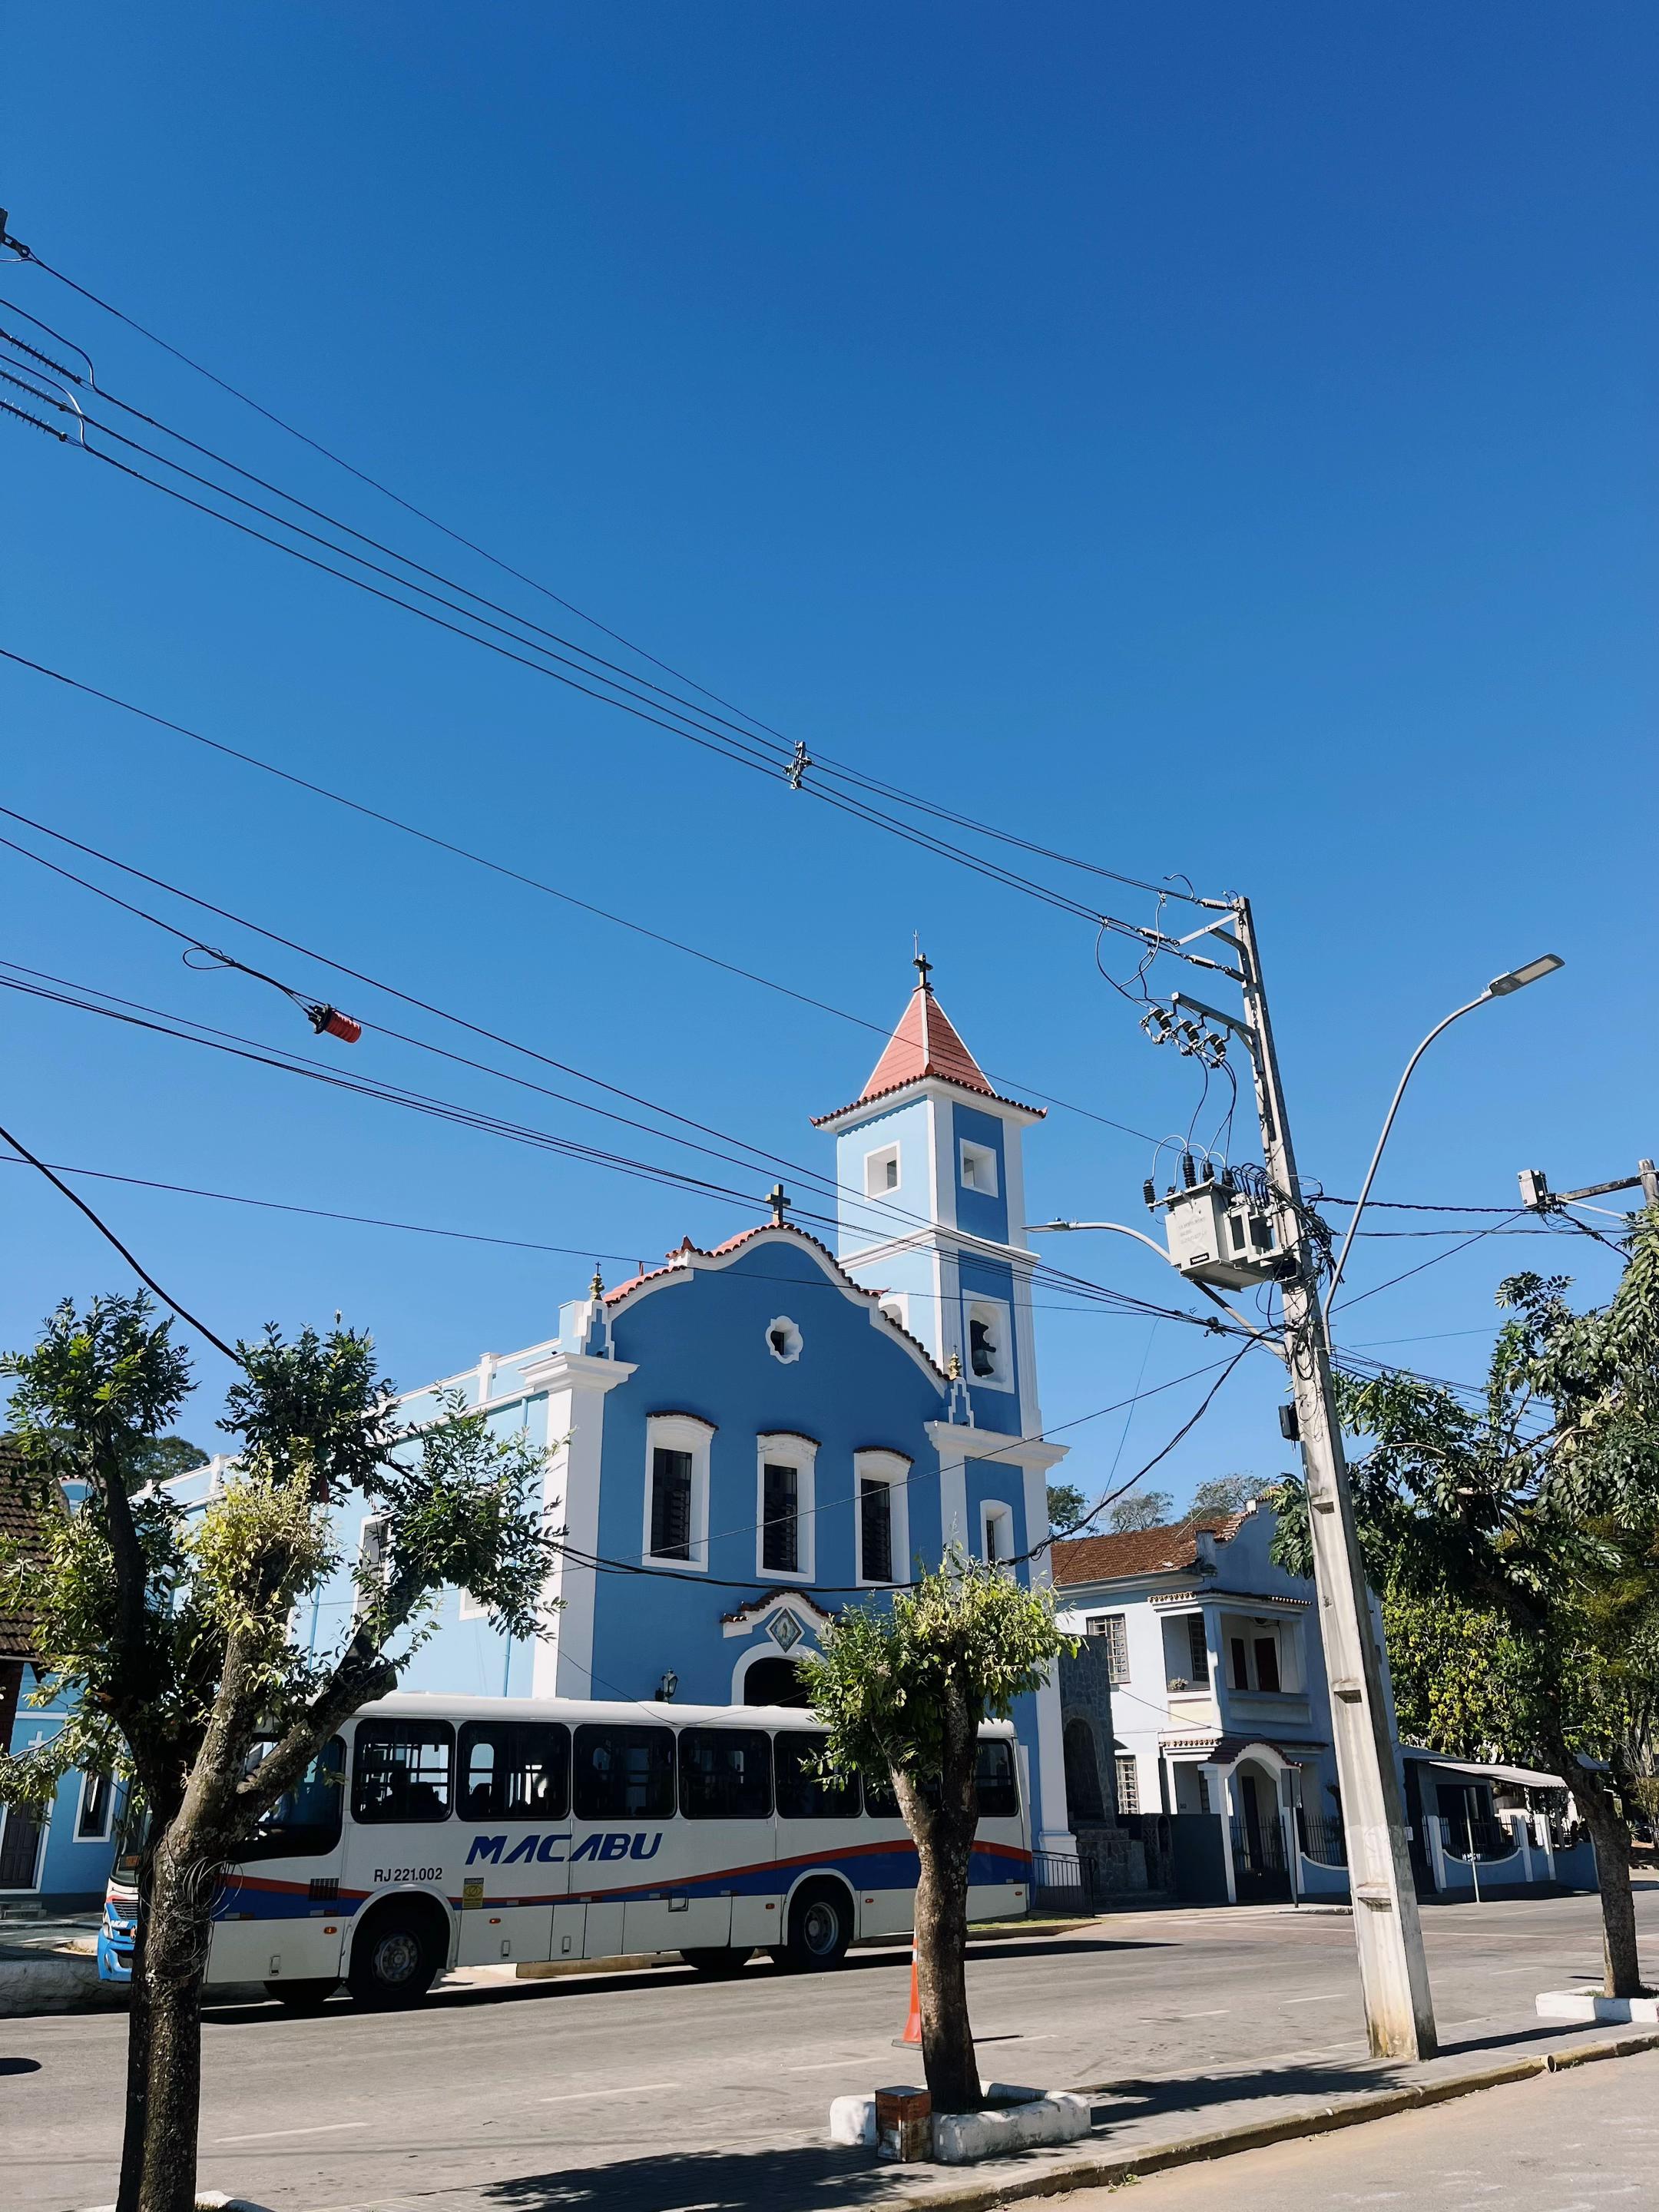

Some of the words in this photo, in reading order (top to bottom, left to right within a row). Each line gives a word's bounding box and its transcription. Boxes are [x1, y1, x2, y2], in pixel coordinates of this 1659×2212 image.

[465, 1833, 663, 1865] MACABU
[374, 1869, 392, 1882] RJ
[394, 1867, 442, 1881] 221.002
